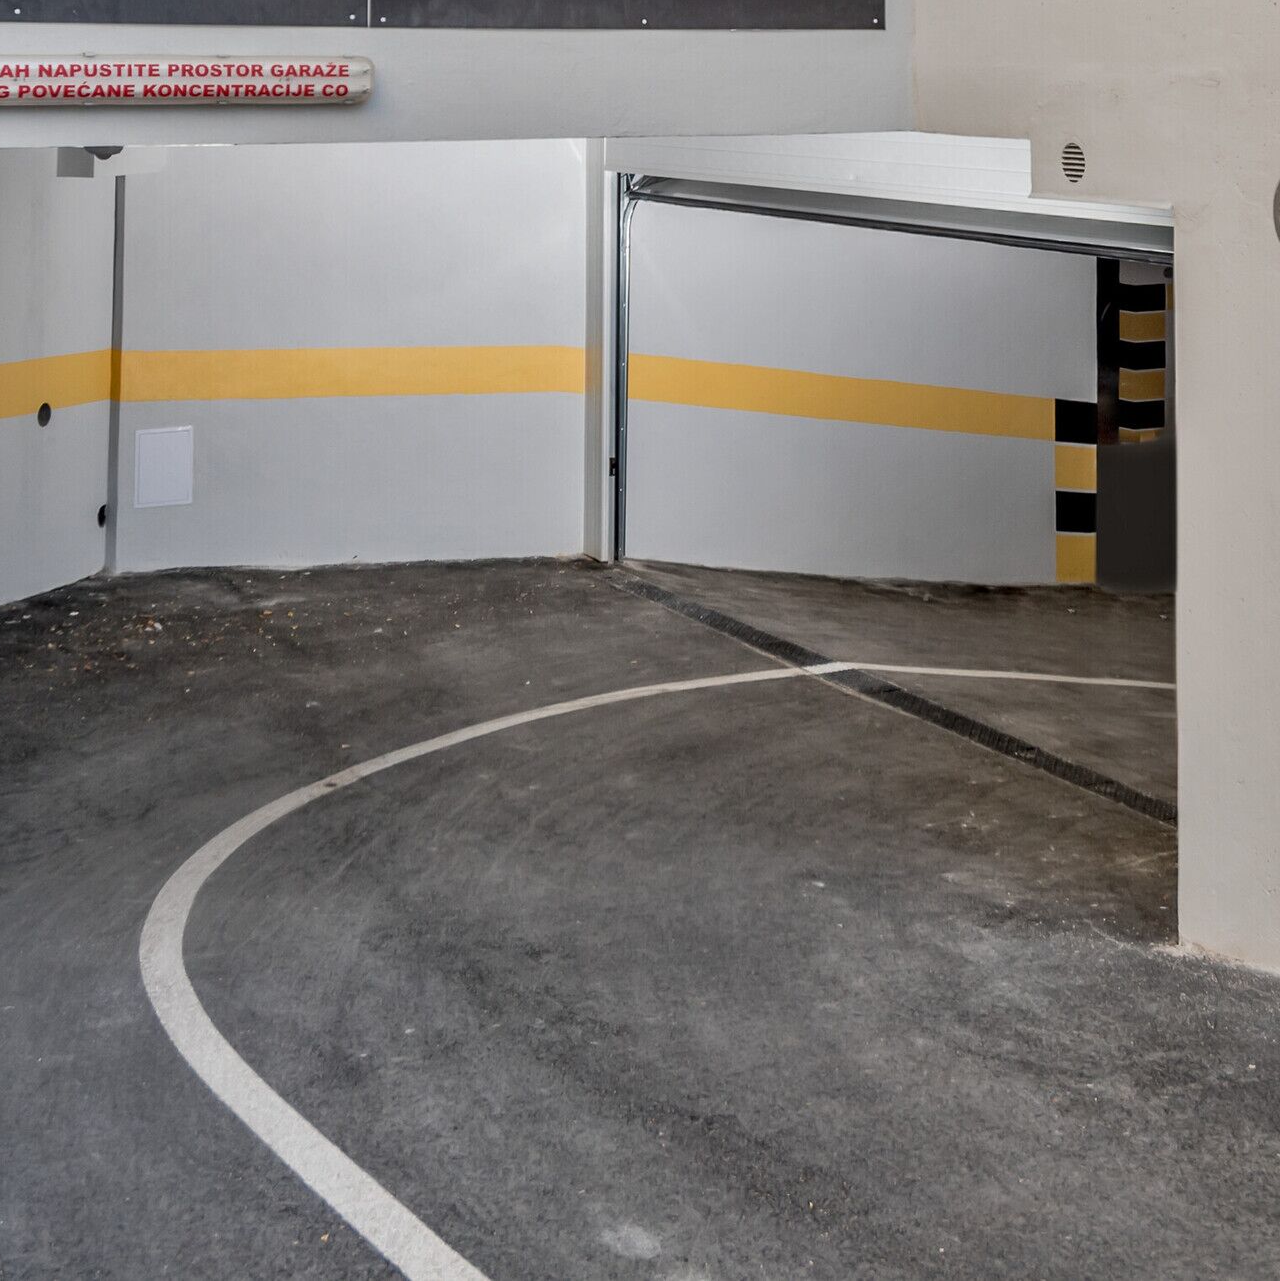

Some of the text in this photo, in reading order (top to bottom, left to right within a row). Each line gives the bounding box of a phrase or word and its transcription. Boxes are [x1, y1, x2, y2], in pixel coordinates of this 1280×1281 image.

[38, 63, 160, 78] NAPUSTITE
[167, 63, 264, 77] PROSTOR
[270, 61, 350, 77] GARAŽE
[18, 81, 135, 99] POVEĆANE
[143, 83, 315, 98] KONCENTRACIJE
[322, 84, 349, 97] CO
